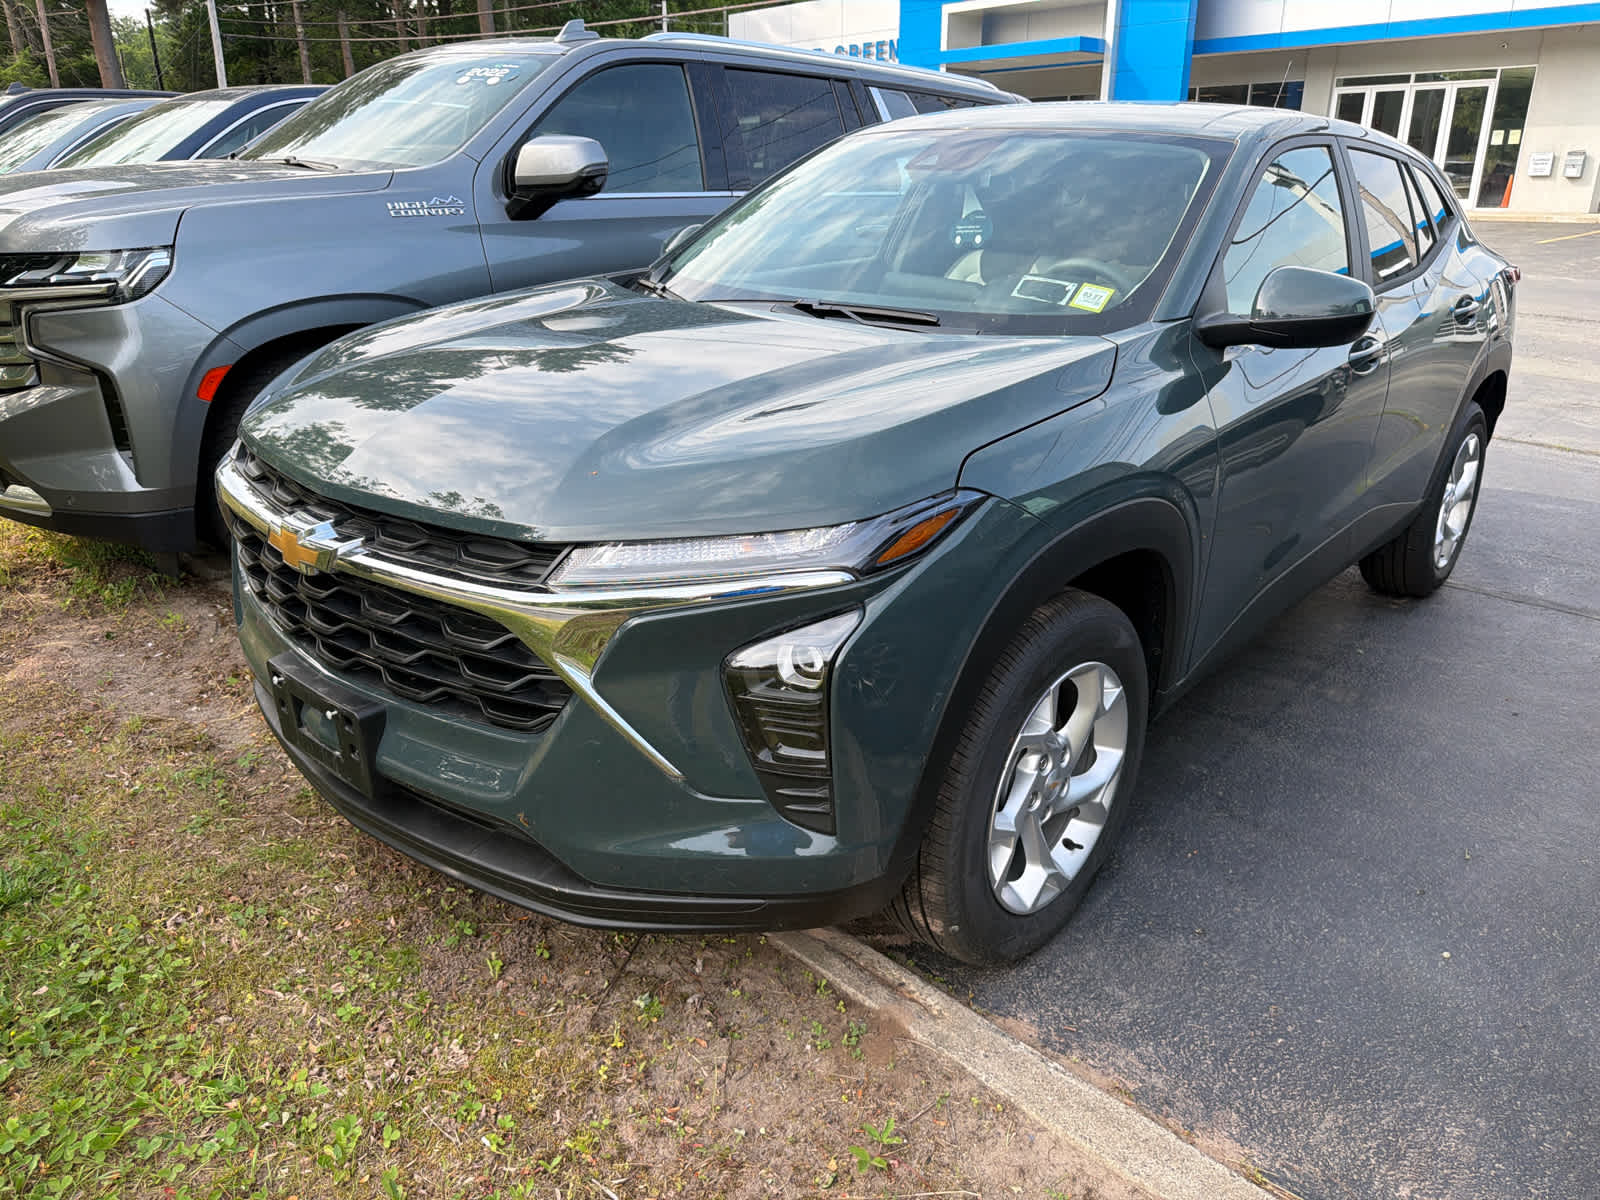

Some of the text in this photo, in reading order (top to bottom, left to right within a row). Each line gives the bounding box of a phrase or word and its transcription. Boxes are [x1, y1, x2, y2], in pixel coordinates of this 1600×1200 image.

[465, 67, 511, 77] 2022
[386, 201, 428, 210] HIGH
[389, 208, 465, 217] COUNTRY
